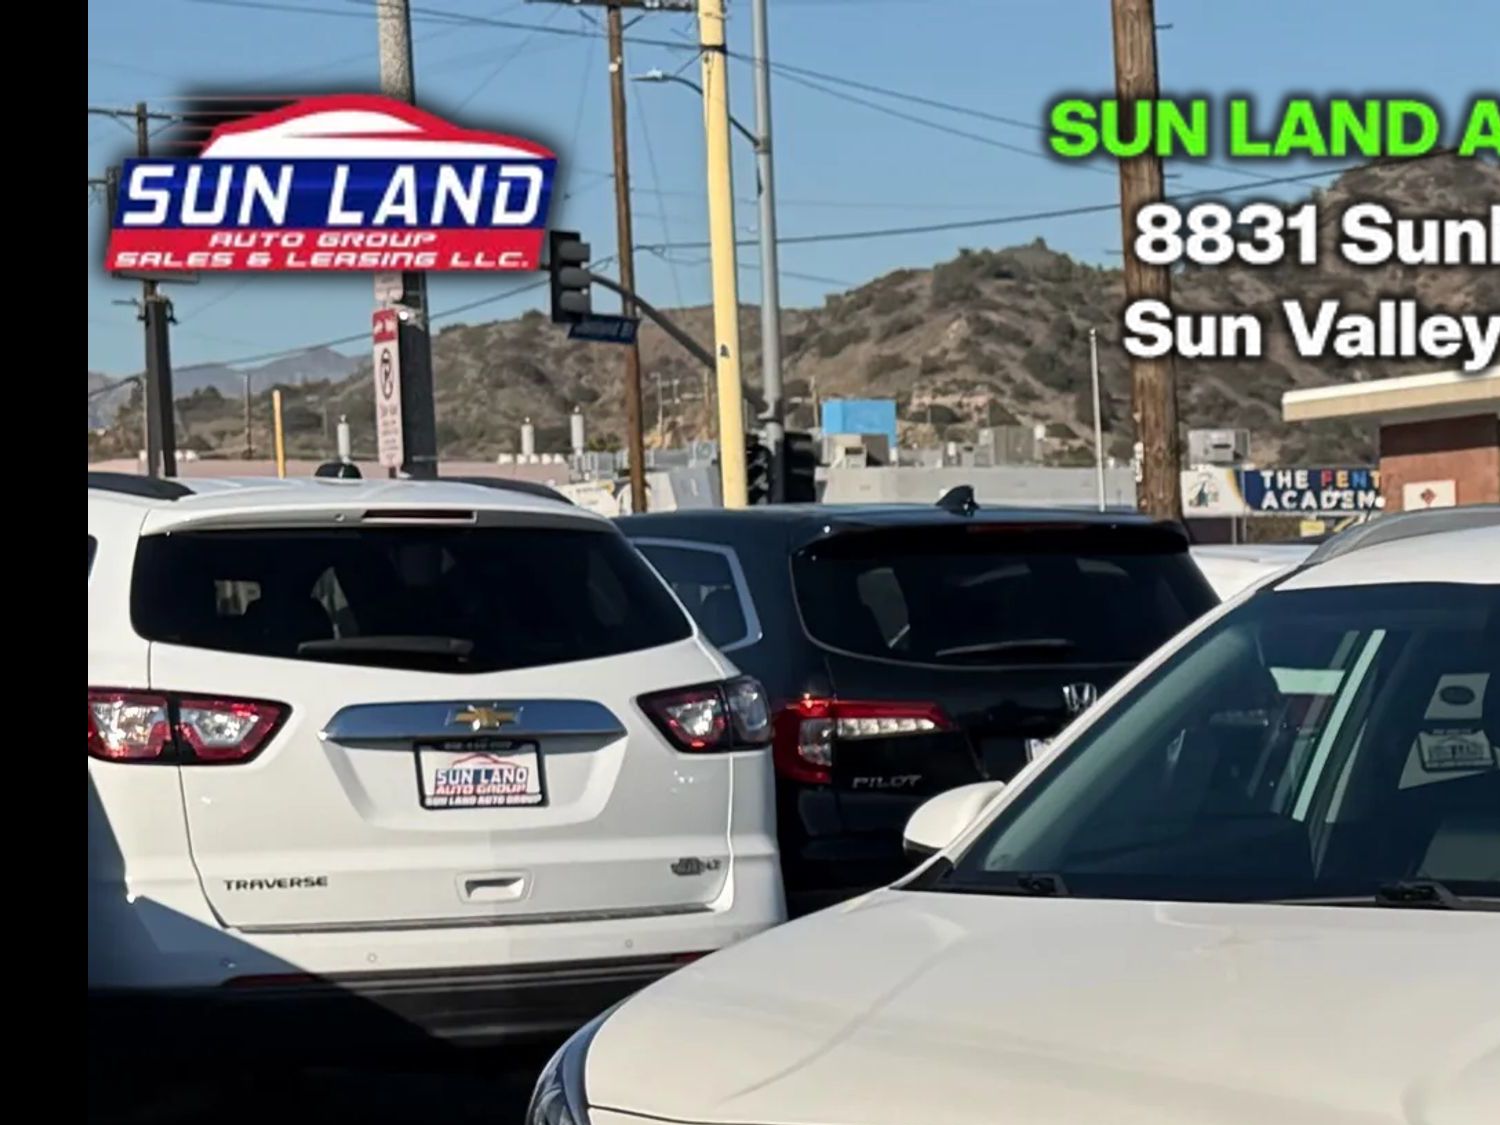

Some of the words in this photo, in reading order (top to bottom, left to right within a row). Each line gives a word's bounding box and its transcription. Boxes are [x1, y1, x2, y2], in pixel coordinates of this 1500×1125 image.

[1260, 469, 1309, 489] THE
[1261, 489, 1386, 510] ACADEM
[437, 768, 474, 785] SUN
[480, 767, 528, 785] LAND
[852, 774, 922, 789] PILOT
[222, 876, 328, 891] TRAVERSE
